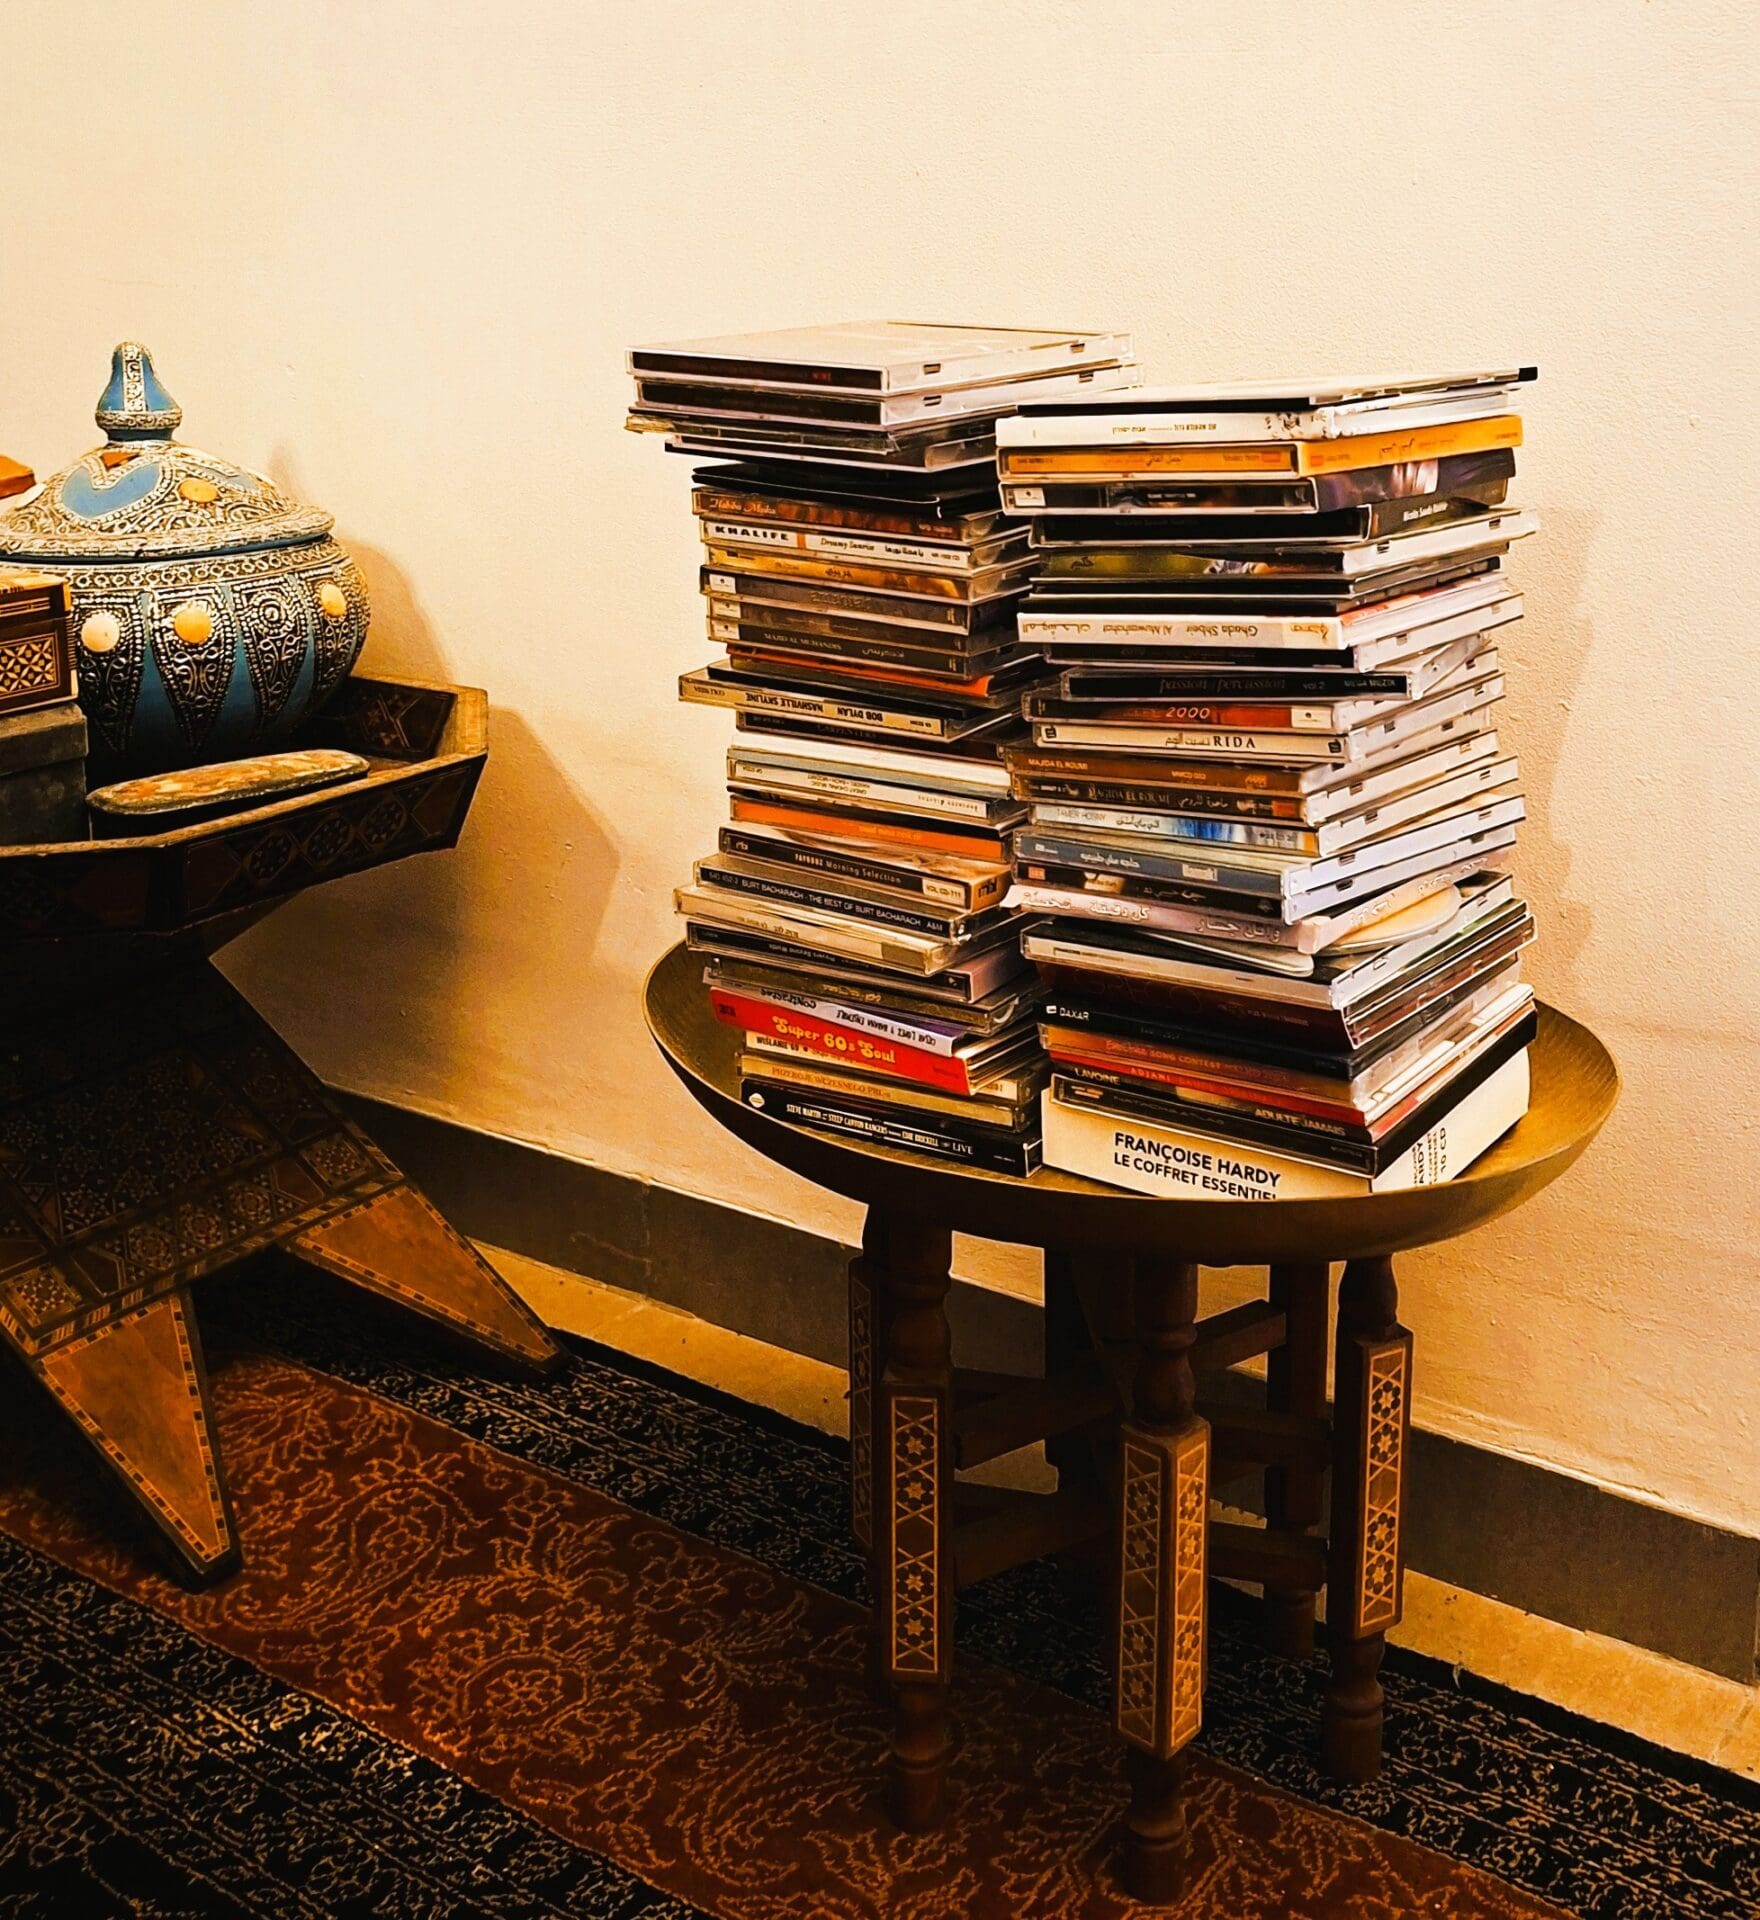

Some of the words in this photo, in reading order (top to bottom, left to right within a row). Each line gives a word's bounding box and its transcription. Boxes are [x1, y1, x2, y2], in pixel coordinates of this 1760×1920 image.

[715, 525, 789, 541] KHALIFE
[1186, 624, 1218, 636] Shbeir
[1221, 624, 1258, 637] Ghada
[746, 692, 778, 706] SKYLINE
[780, 697, 823, 713] NASHVILLE
[837, 706, 864, 719] DYLAN
[866, 710, 883, 722] BOB
[1166, 707, 1210, 719] 2000
[1213, 736, 1256, 749] RIDA
[825, 860, 859, 876] Morning
[862, 868, 902, 884] Selection
[741, 880, 760, 890] BURT
[761, 882, 804, 900] BACHARACH
[809, 894, 822, 904] THE
[824, 897, 842, 908] BEST
[844, 901, 853, 911] OF
[855, 904, 874, 915] BURT
[876, 908, 921, 926] BACHARACH
[772, 1015, 820, 1042] Super
[858, 1039, 896, 1064] Soul
[1073, 1066, 1120, 1085] LAVOINE
[786, 1104, 801, 1115] STEVE
[802, 1107, 821, 1119] MARTIN
[828, 1113, 844, 1124] STEEP
[844, 1115, 864, 1129] CANYON
[865, 1122, 888, 1135] RANGERS
[952, 1141, 974, 1155] LIVE
[1254, 1107, 1300, 1126] ADULTE
[1301, 1119, 1347, 1138] JAMAIS
[1440, 1127, 1447, 1151] CD
[1114, 1152, 1130, 1168] LE
[1133, 1156, 1199, 1186] COFFRET
[1115, 1132, 1212, 1171] FRANÇOISE
[1217, 1158, 1281, 1188] HARDY
[1416, 1142, 1425, 1184] ARDY
[1440, 1154, 1447, 1173] 10
